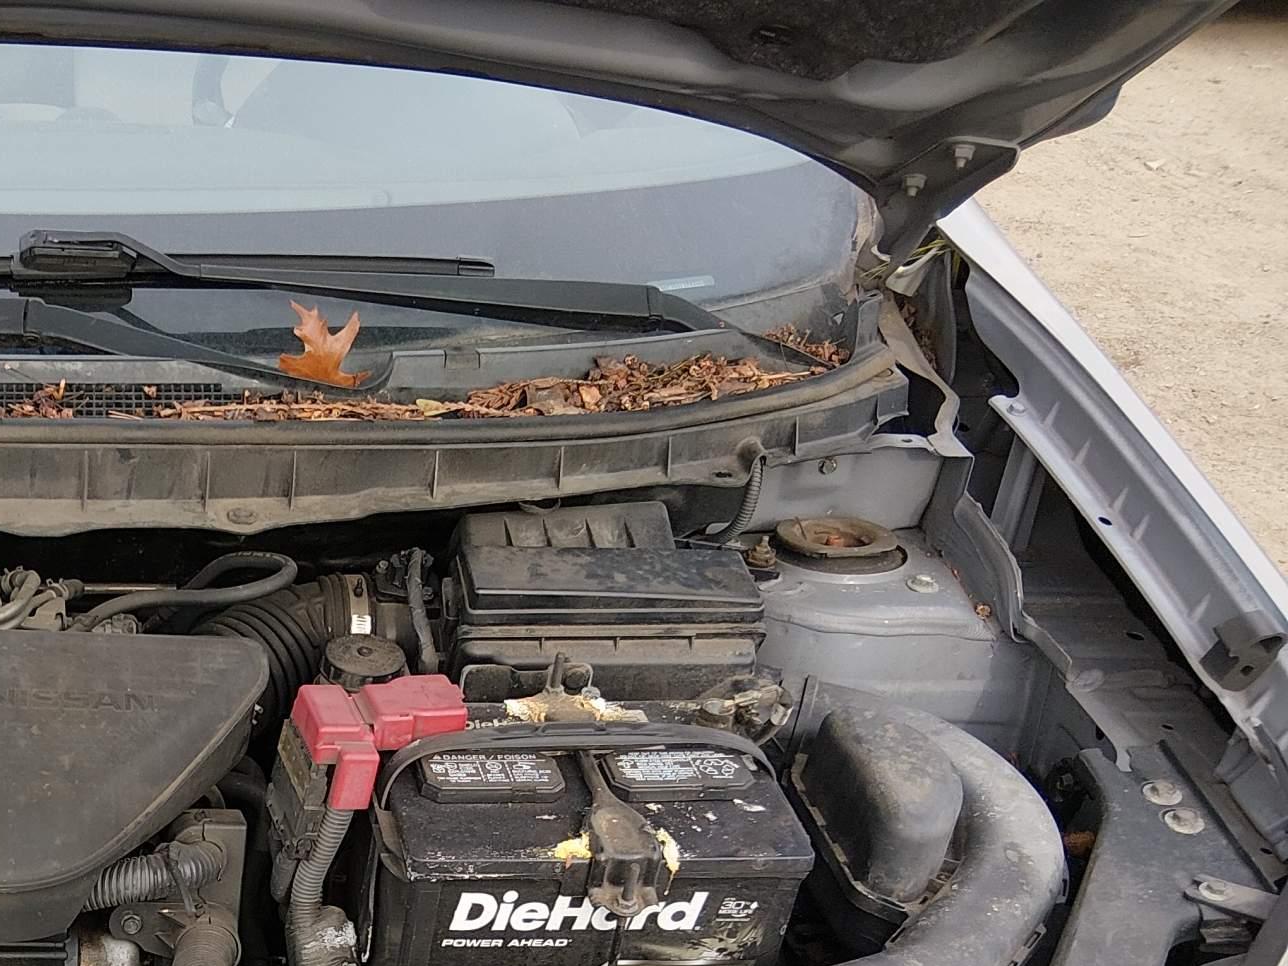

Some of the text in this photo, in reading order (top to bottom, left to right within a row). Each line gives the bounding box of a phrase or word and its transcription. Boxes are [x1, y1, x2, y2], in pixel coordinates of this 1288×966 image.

[497, 753, 537, 761] POISON
[440, 938, 571, 948] POWER AHEAD
